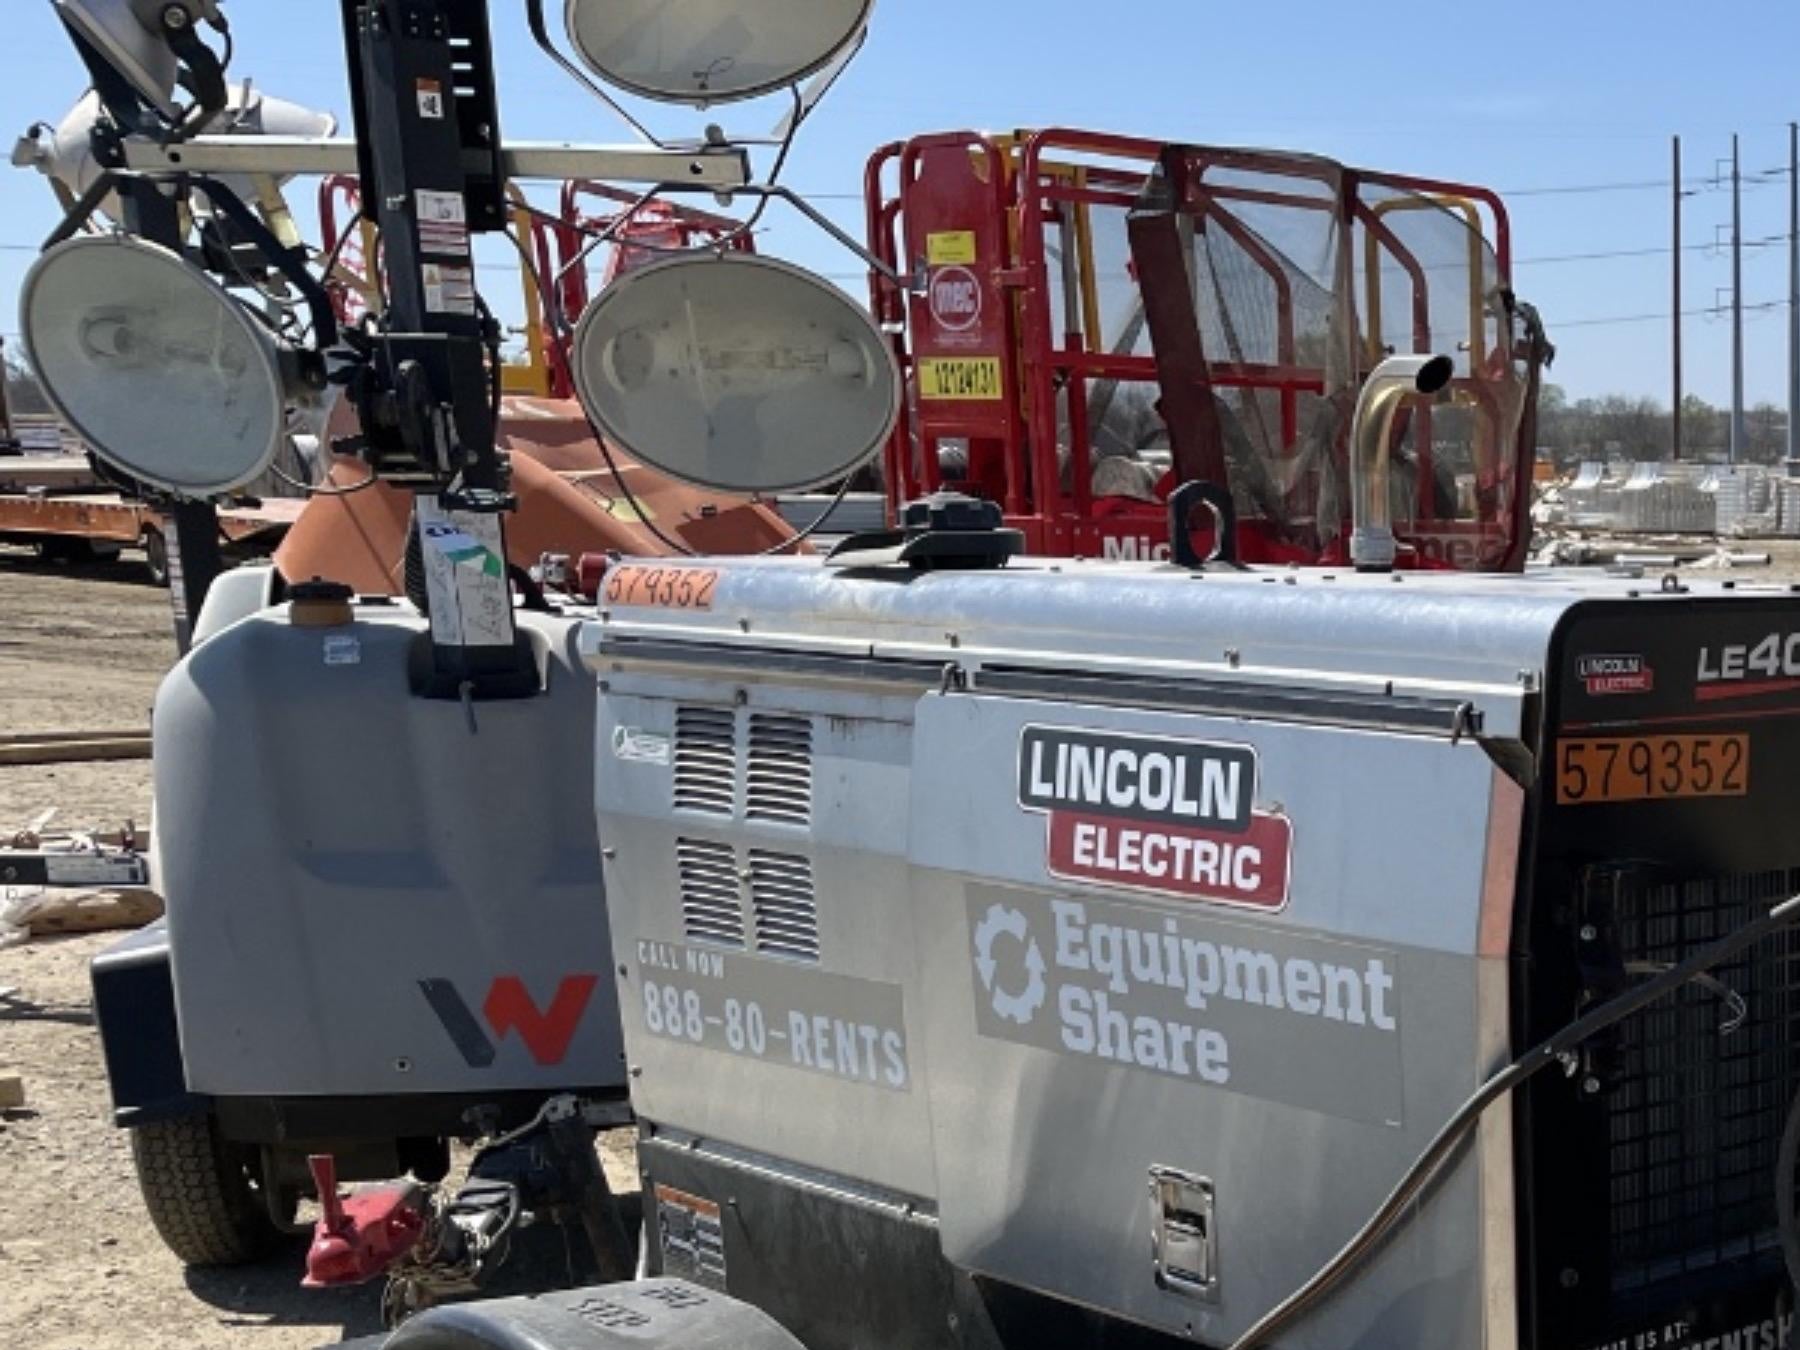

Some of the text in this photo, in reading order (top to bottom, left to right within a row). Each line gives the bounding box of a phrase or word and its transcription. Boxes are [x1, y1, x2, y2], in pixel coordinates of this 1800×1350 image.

[606, 566, 718, 607] 579352
[1030, 740, 1242, 820] LINCOLN
[1562, 738, 1742, 799] 579352
[1072, 823, 1262, 892] ELECTRIC
[638, 941, 725, 979] CALL NOW
[1051, 900, 1397, 1031] Equipment
[643, 981, 906, 1087] 888-80-RENTS
[1058, 985, 1230, 1085] Share
